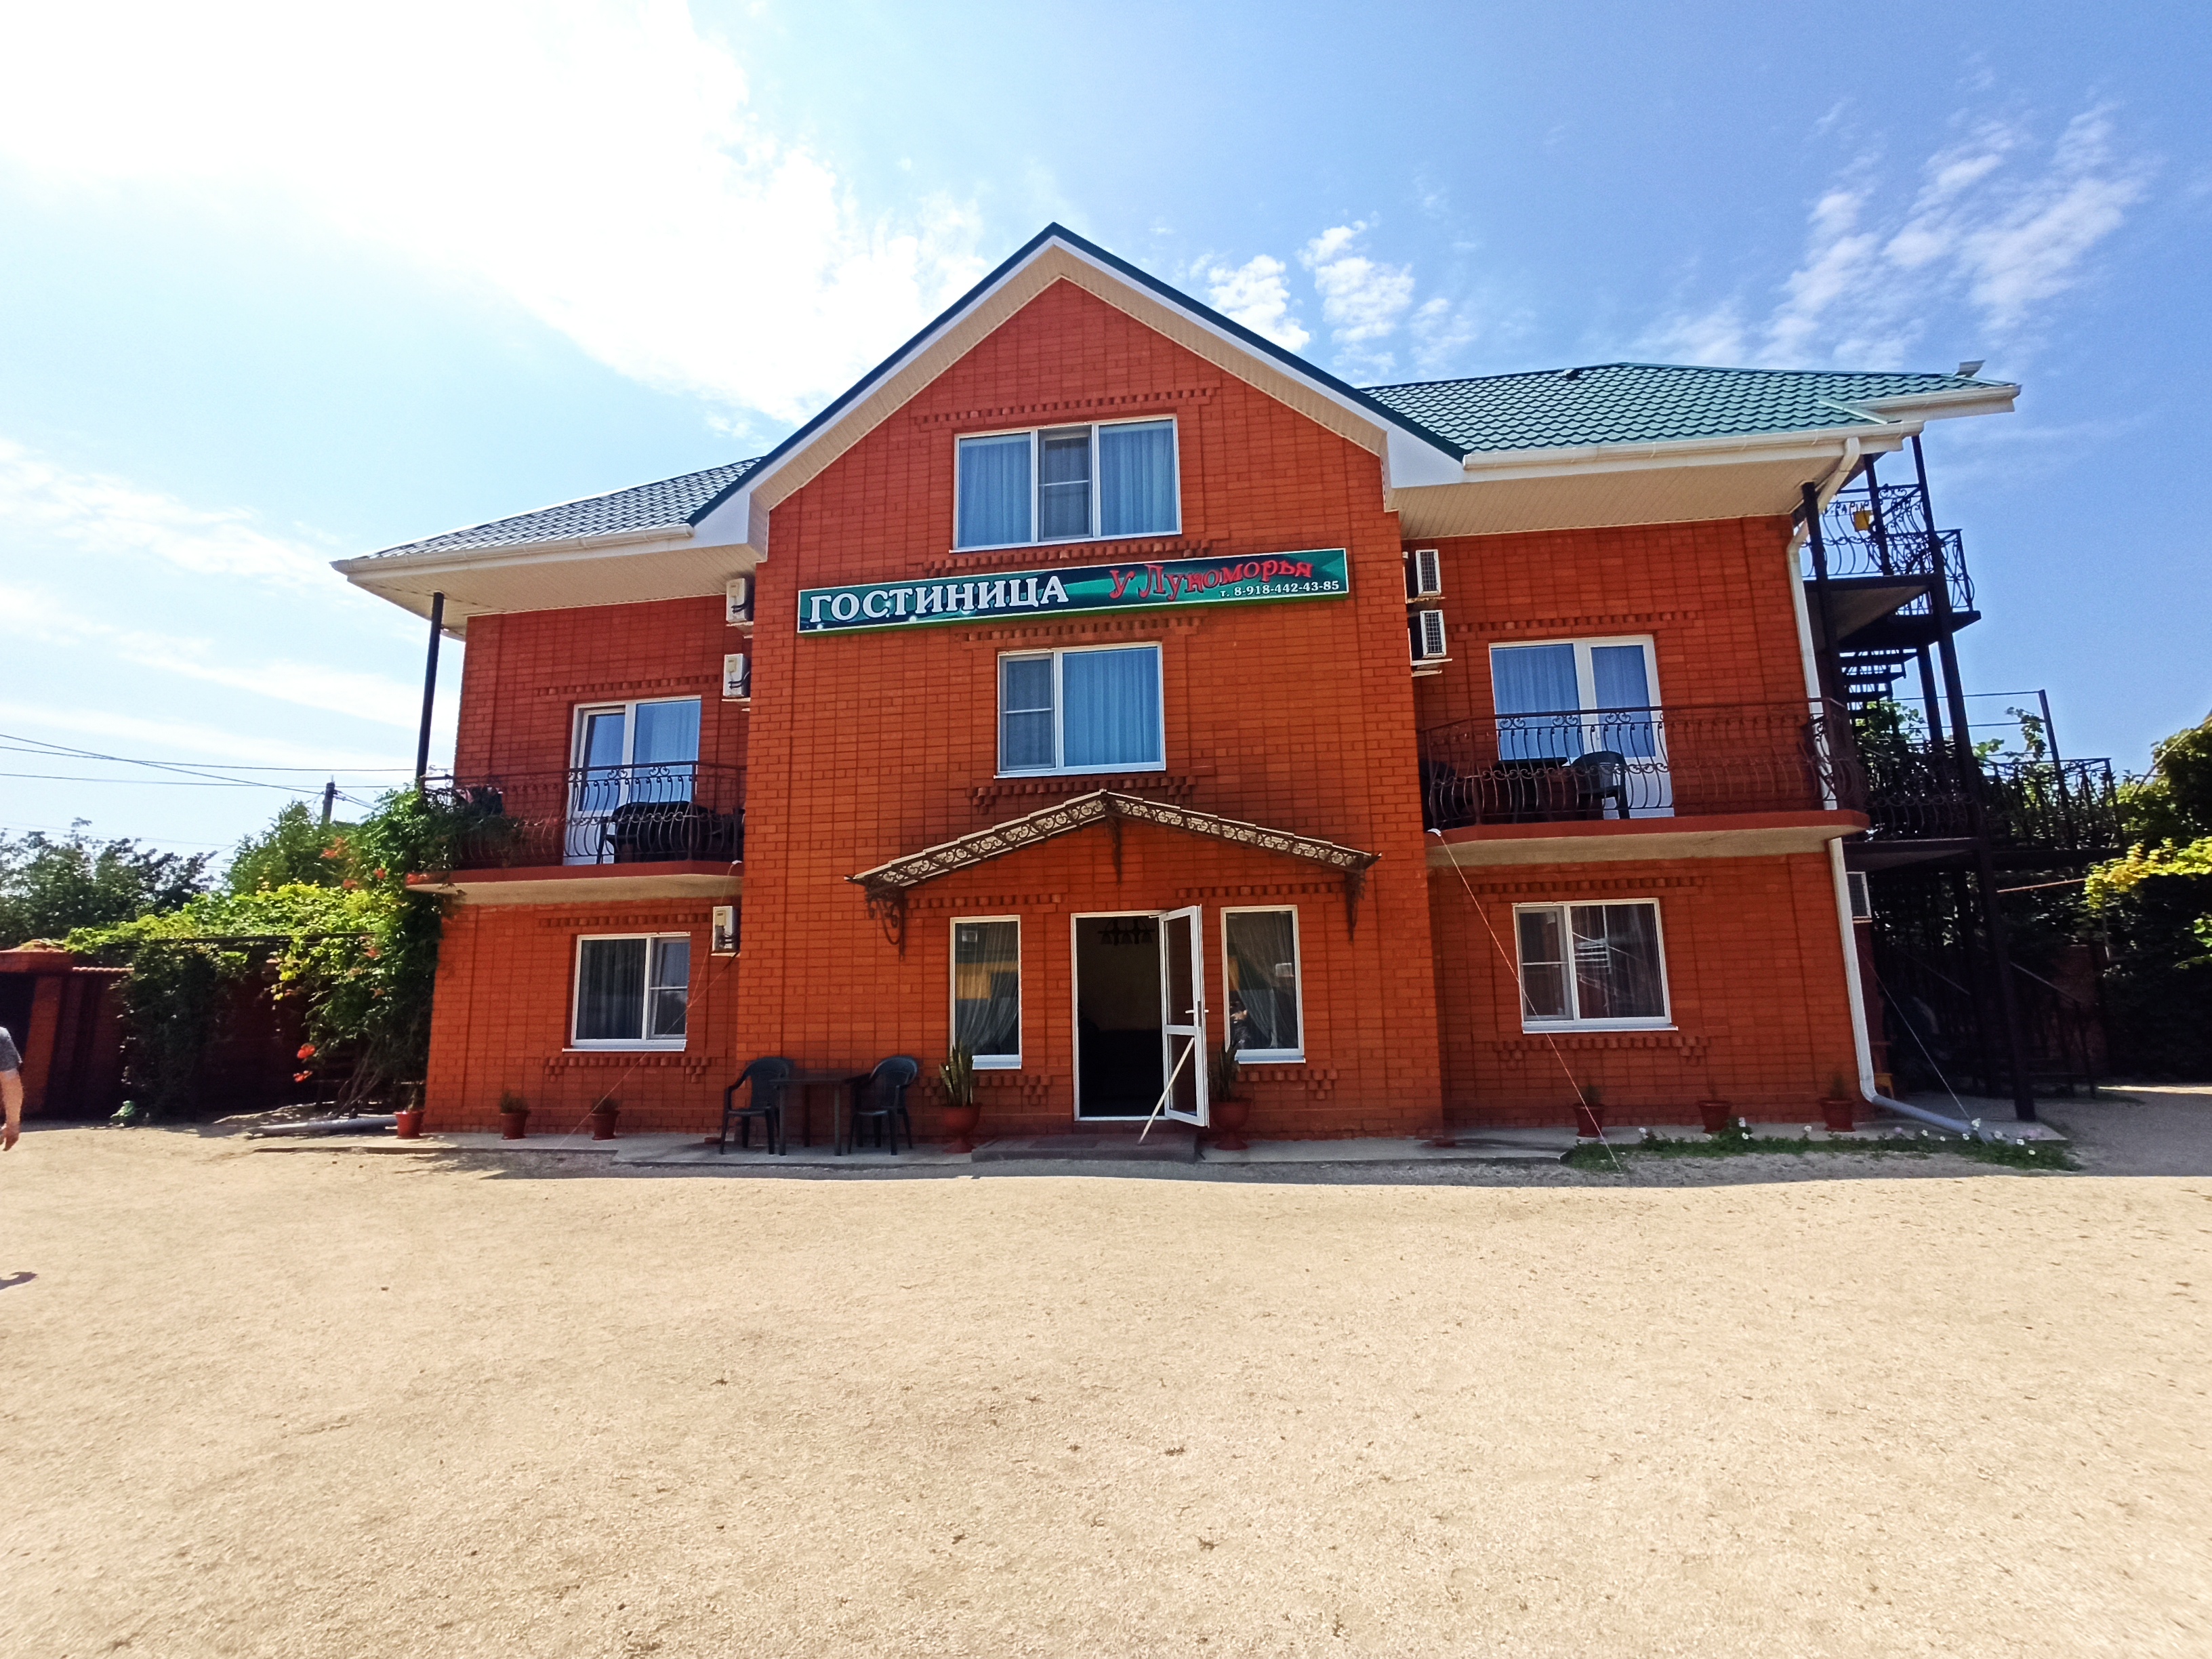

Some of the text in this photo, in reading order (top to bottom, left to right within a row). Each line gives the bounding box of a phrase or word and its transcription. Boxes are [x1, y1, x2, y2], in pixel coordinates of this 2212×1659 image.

[810, 575, 1069, 623] ГОСТИНИЦА
[1138, 558, 1315, 602] Лукоморья
[1234, 580, 1339, 596] 8-918-442-43-85
